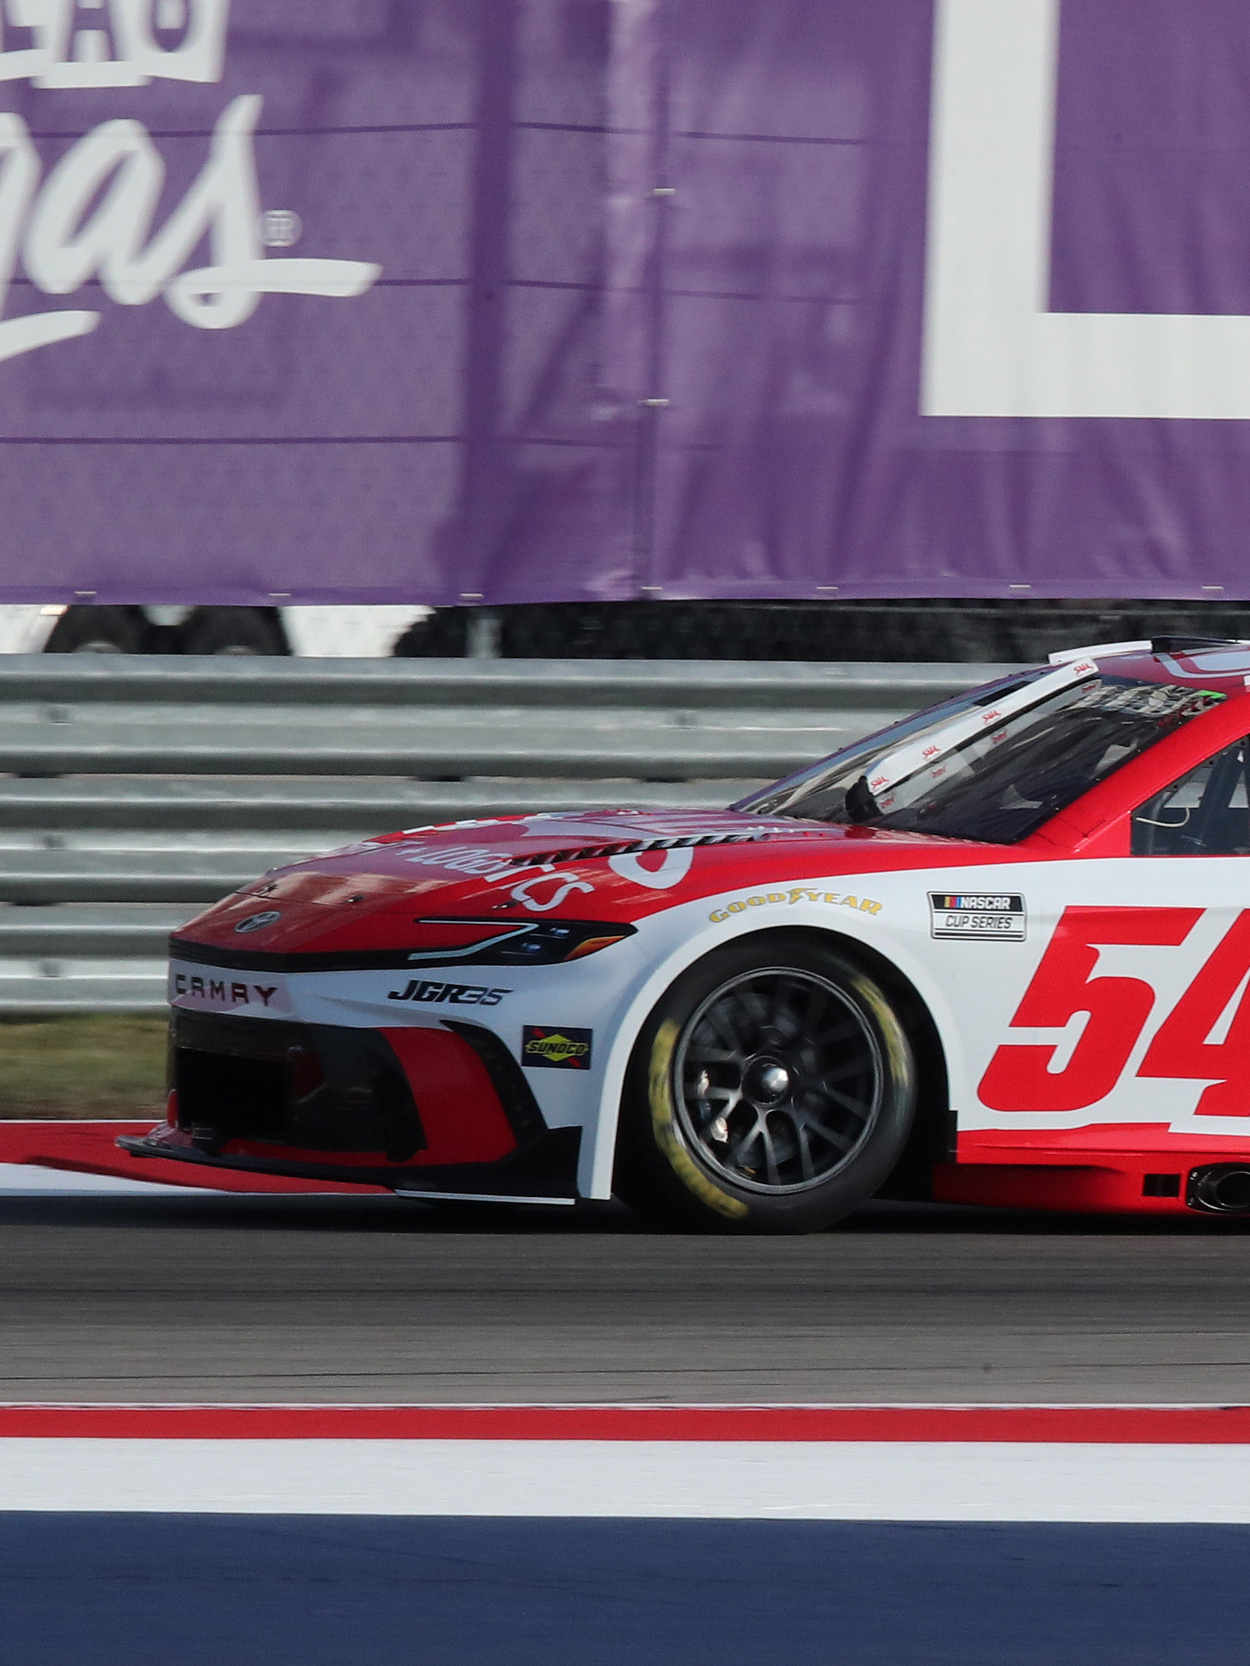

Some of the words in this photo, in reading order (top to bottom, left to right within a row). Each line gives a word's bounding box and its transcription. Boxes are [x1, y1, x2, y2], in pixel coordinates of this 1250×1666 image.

[709, 887, 883, 923] GOODYEAR
[960, 897, 1011, 910] NASCAR
[945, 914, 969, 928] CUP
[971, 915, 1013, 930] SERIES
[175, 974, 278, 1007] CAMRY
[527, 1040, 589, 1056] SUNOCO
